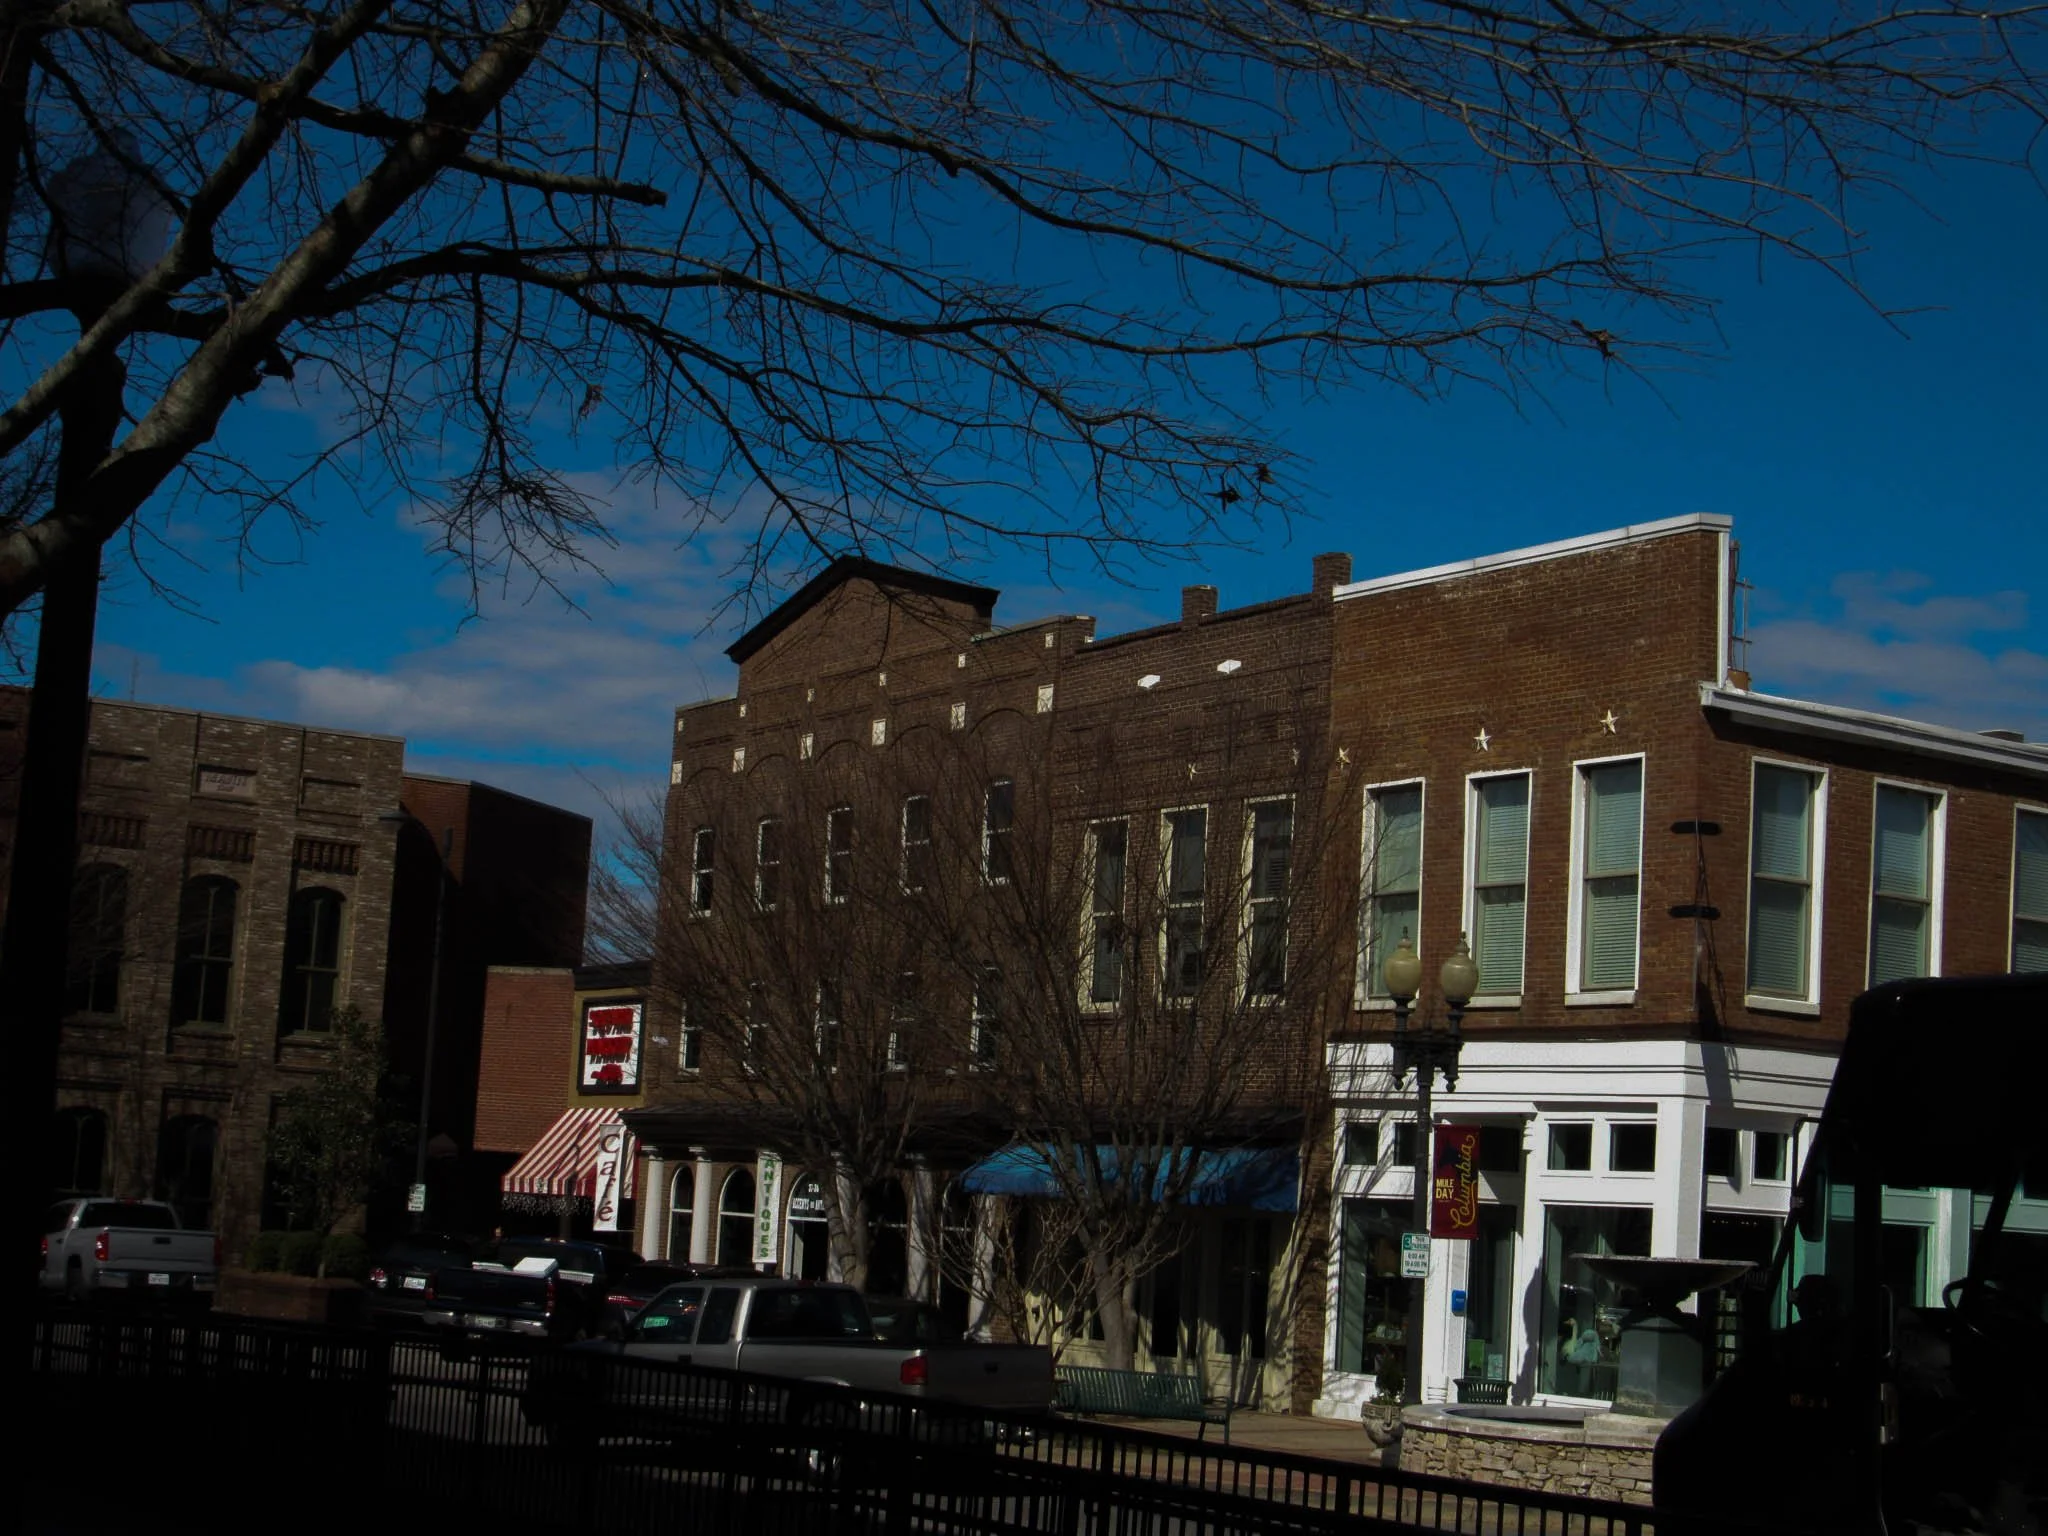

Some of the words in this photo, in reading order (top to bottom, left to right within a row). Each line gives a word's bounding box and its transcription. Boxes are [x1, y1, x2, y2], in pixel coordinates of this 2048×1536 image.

[598, 1133, 620, 1221] Café
[759, 1158, 775, 1258] ANTIQUES
[1435, 1188, 1454, 1200] DAY
[1436, 1178, 1455, 1188] MULE
[1449, 1134, 1477, 1228] Columbia
